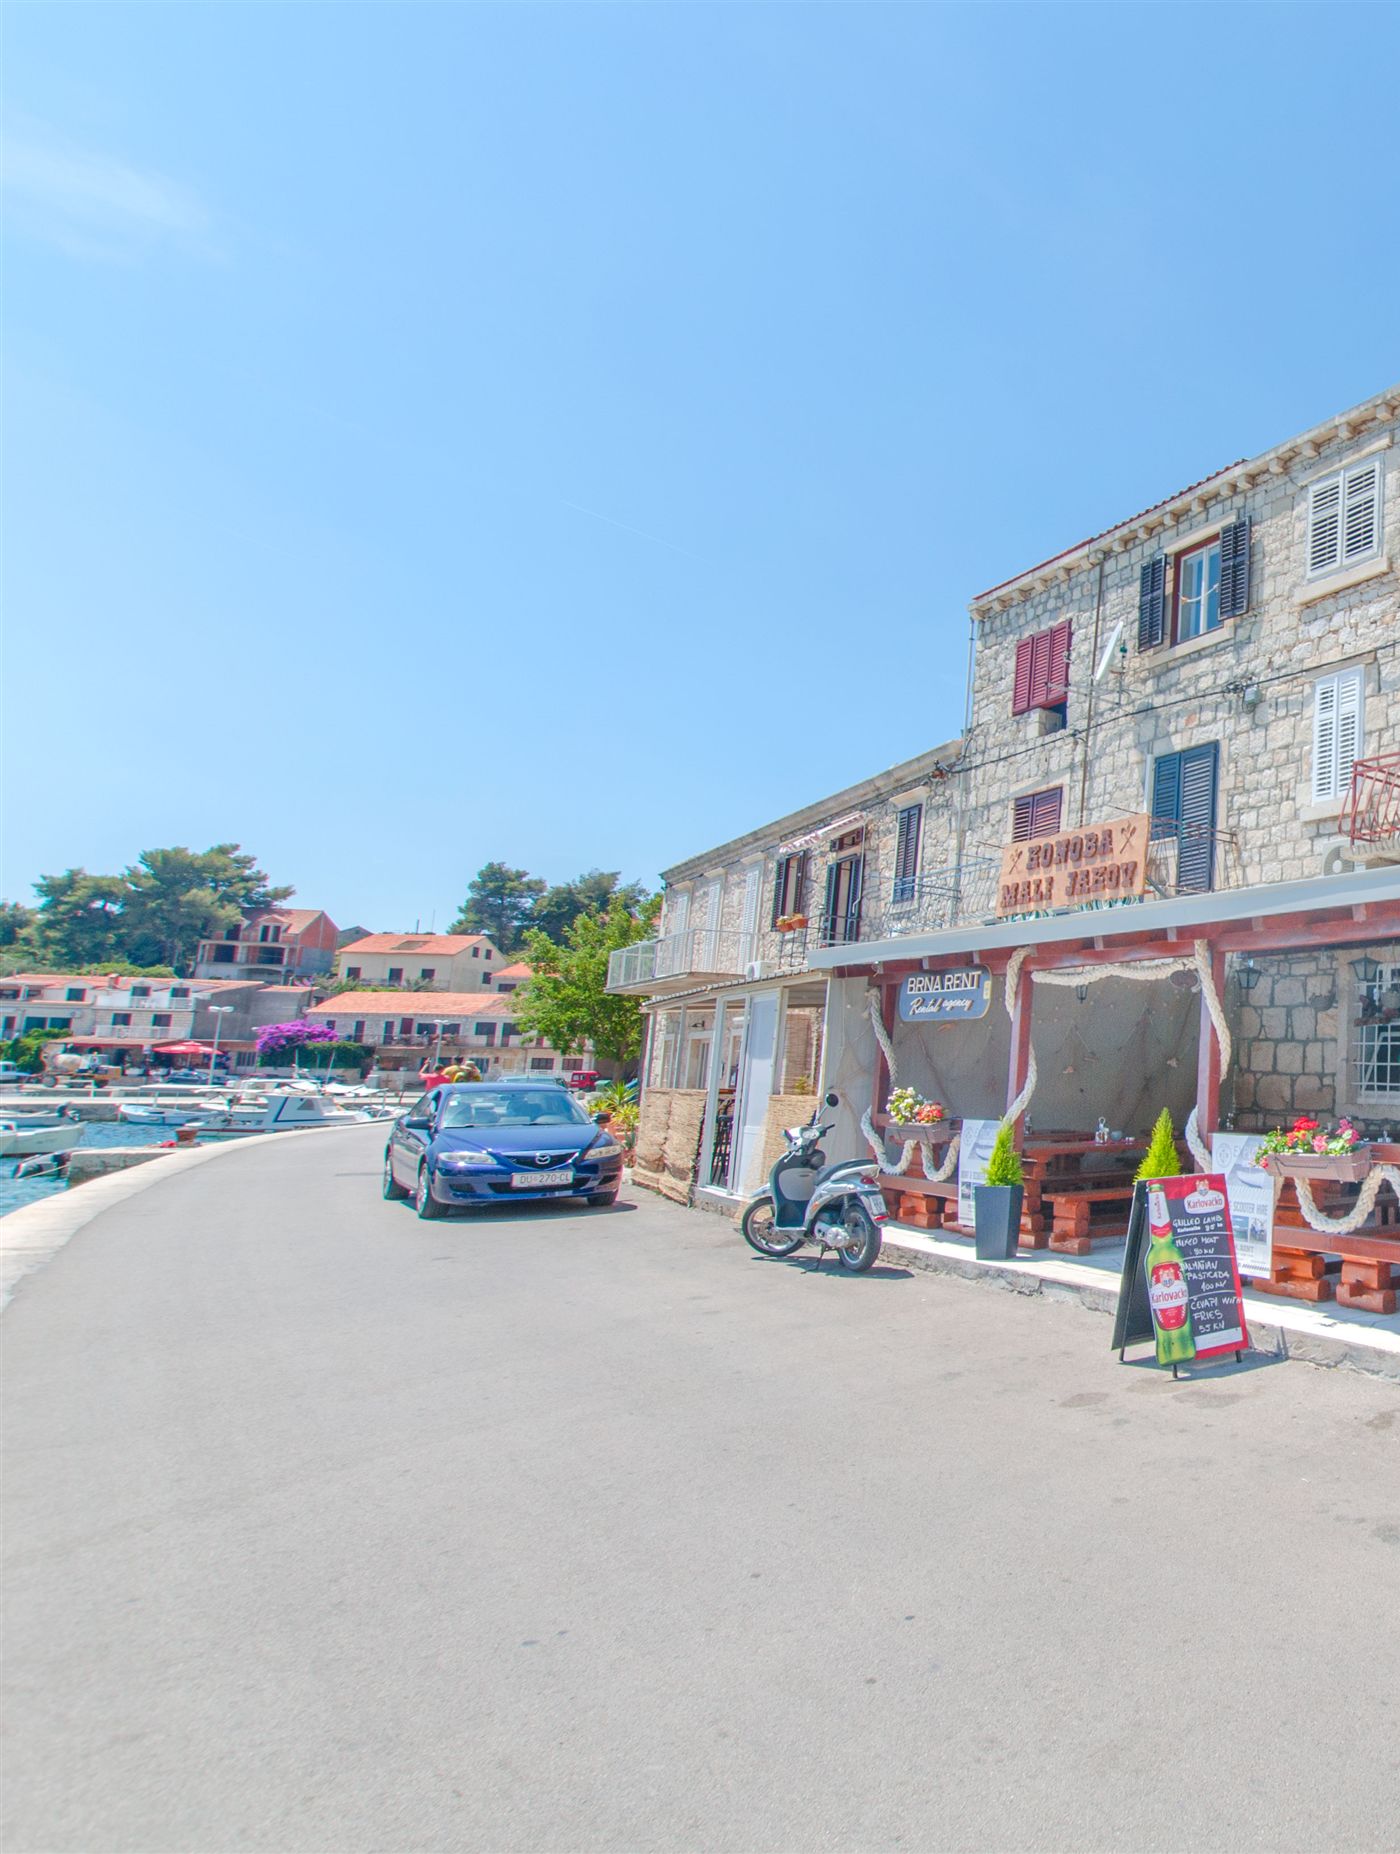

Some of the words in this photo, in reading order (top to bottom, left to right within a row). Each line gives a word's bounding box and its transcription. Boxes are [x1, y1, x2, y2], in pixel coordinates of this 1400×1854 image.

[1026, 829, 1114, 871] KONOBA
[1001, 877, 1054, 909] MALI
[1065, 861, 1137, 898] JAKOV
[907, 975, 942, 994] BRNA
[944, 971, 982, 991] RENT
[909, 997, 943, 1015] Rental
[942, 998, 973, 1012] agency
[520, 1175, 532, 1184] DU
[1203, 1215, 1223, 1224] LAMB
[1192, 1310, 1223, 1320] FRIES
